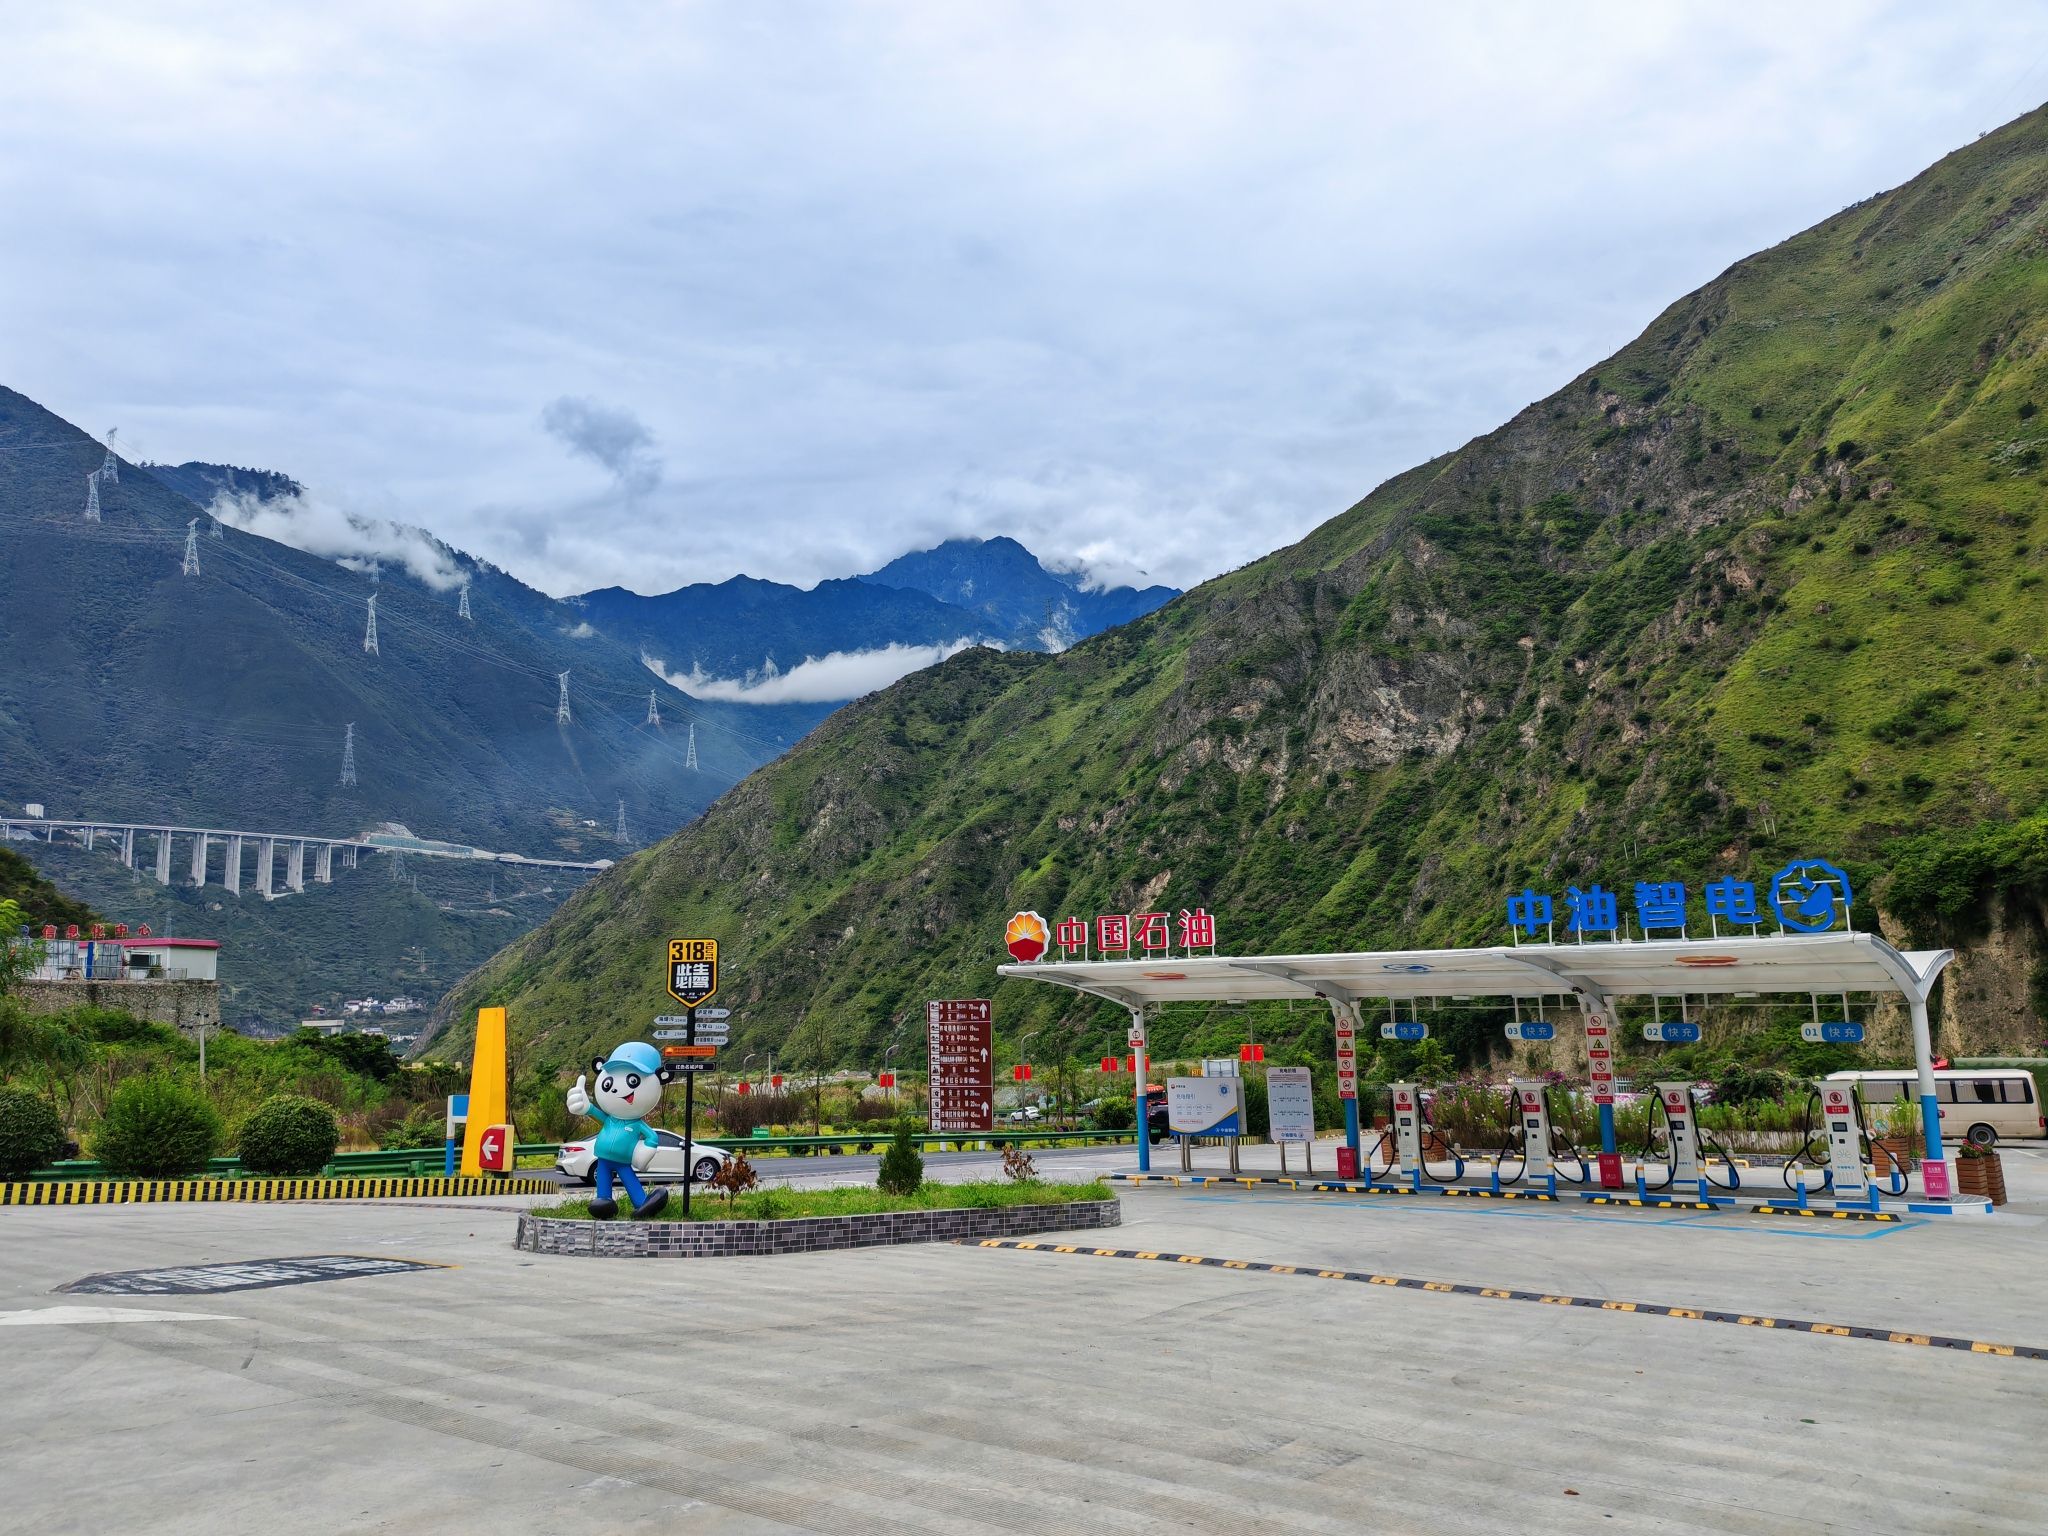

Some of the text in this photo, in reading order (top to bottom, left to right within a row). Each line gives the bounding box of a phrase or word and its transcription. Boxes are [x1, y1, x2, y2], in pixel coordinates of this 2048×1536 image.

[1507, 876, 1762, 935] 中油智电
[42, 922, 153, 940] 信息化中心
[1057, 908, 1216, 953] 中国石油
[672, 942, 714, 960] 318 ROUTE
[677, 963, 709, 976] 此生
[676, 976, 709, 989] 必驾
[1400, 1026, 1419, 1035] 快充
[1508, 1026, 1547, 1036] 03 快充
[1647, 1026, 1692, 1037] 02 快充
[1805, 1026, 1856, 1038] 01 快充
